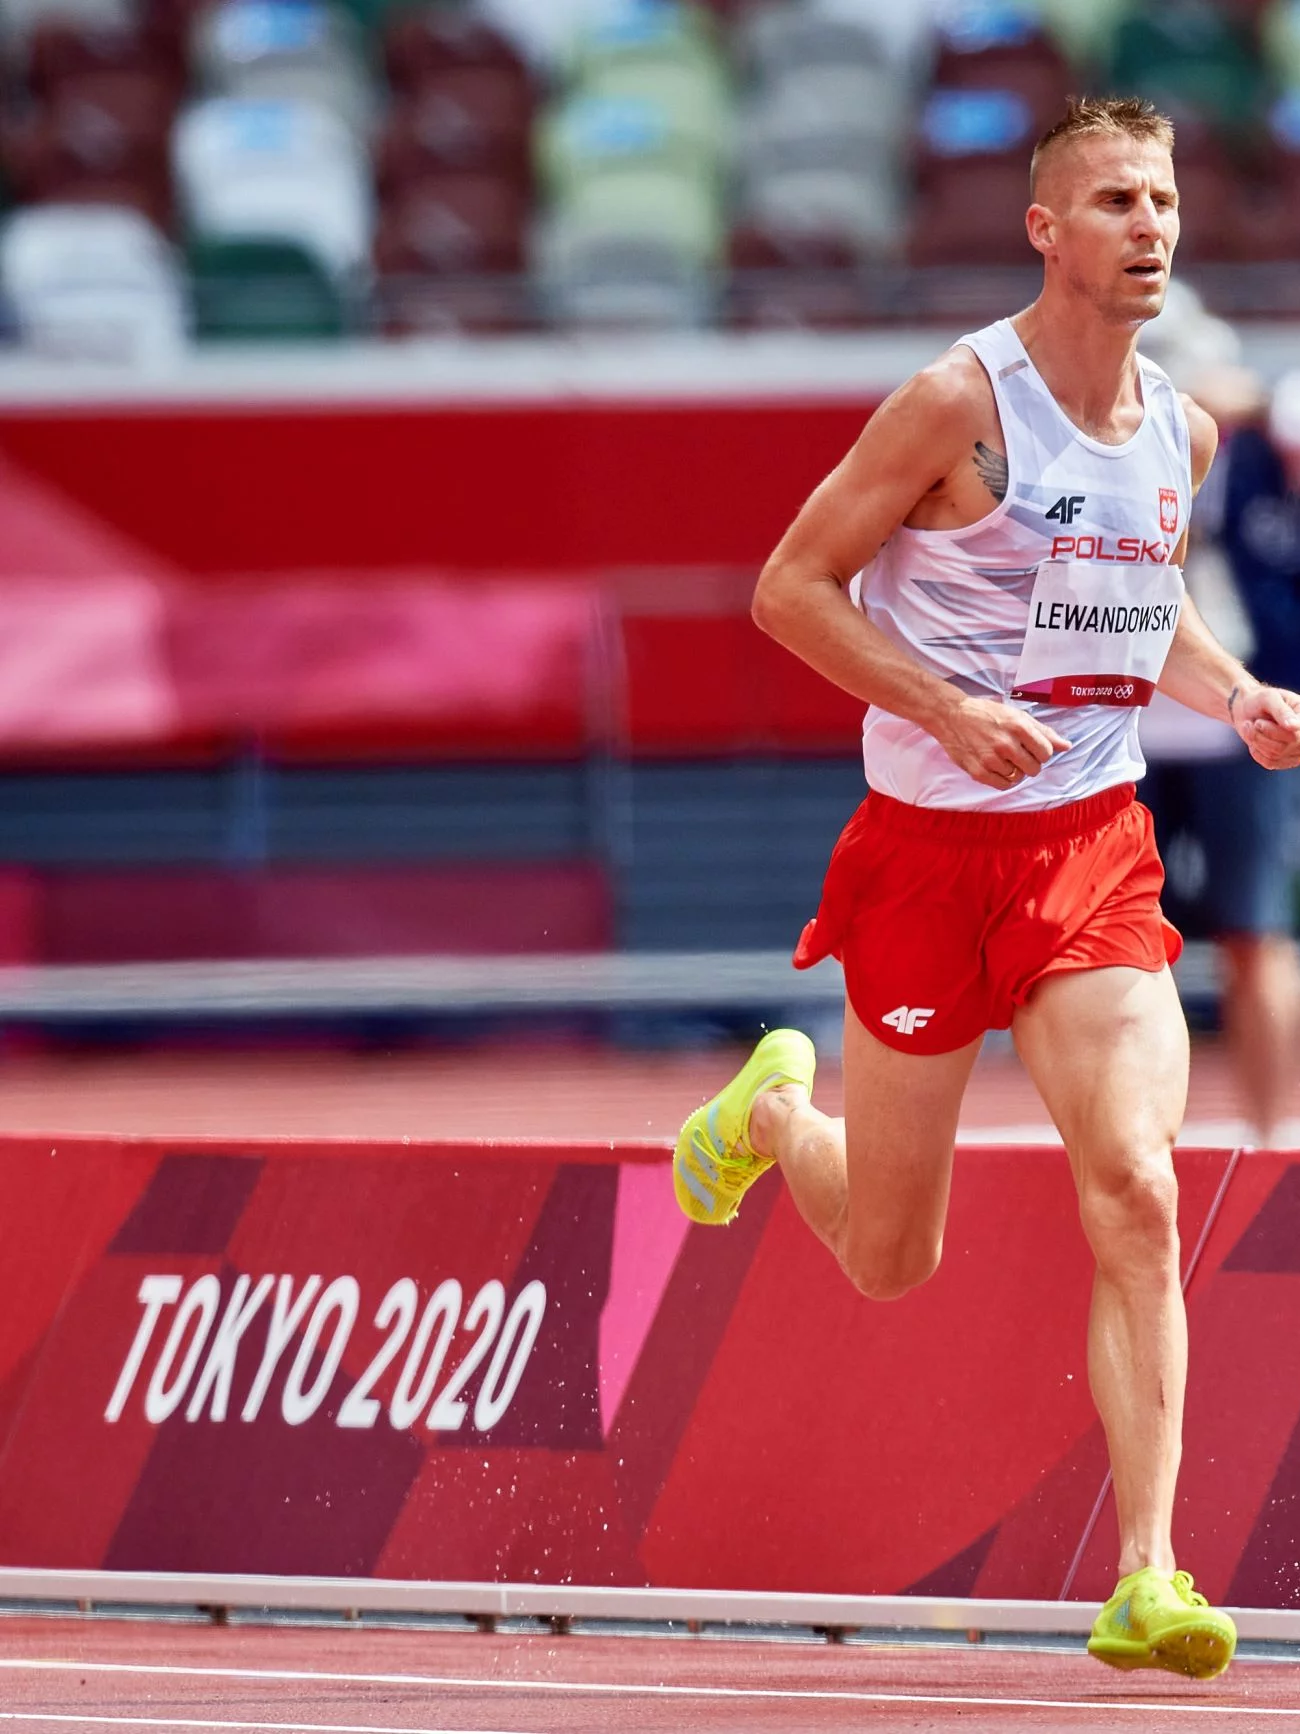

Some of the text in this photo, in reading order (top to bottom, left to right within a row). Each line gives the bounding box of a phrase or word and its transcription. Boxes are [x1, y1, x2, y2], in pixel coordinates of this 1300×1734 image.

[1045, 496, 1085, 524] 4F
[1034, 601, 1178, 633] LEWANDOWSKI
[1071, 686, 1112, 696] TOKYO 2020
[882, 1005, 935, 1035] 4F
[104, 1273, 547, 1431] TOKYO 2020
